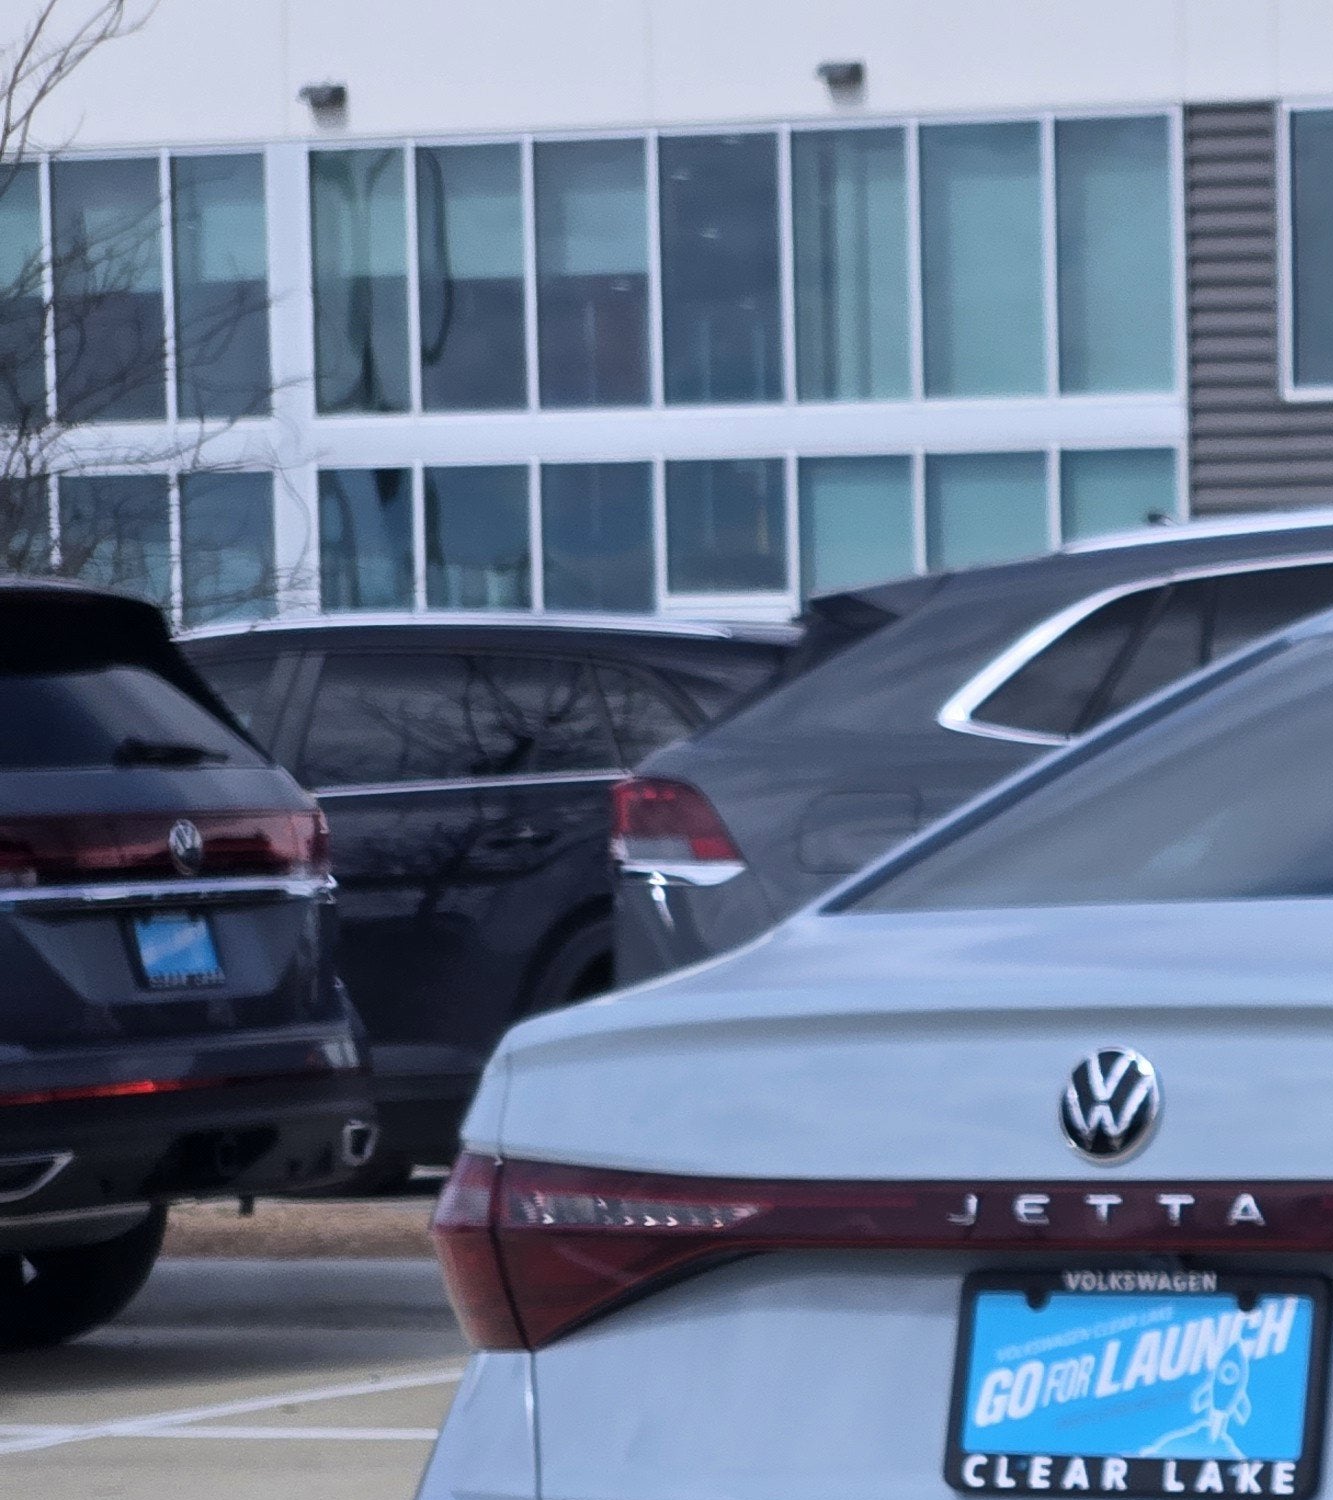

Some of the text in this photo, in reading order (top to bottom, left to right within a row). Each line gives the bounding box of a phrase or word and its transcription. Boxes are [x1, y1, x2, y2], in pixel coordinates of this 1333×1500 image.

[947, 1193, 1266, 1226] JETTA
[1064, 1271, 1217, 1292] VOLKSWAGEN
[974, 1360, 1045, 1428] GO
[1042, 1355, 1095, 1408] FOR
[1094, 1297, 1299, 1399] LAUNCH
[961, 1456, 1297, 1495] CLEAR LAKE
